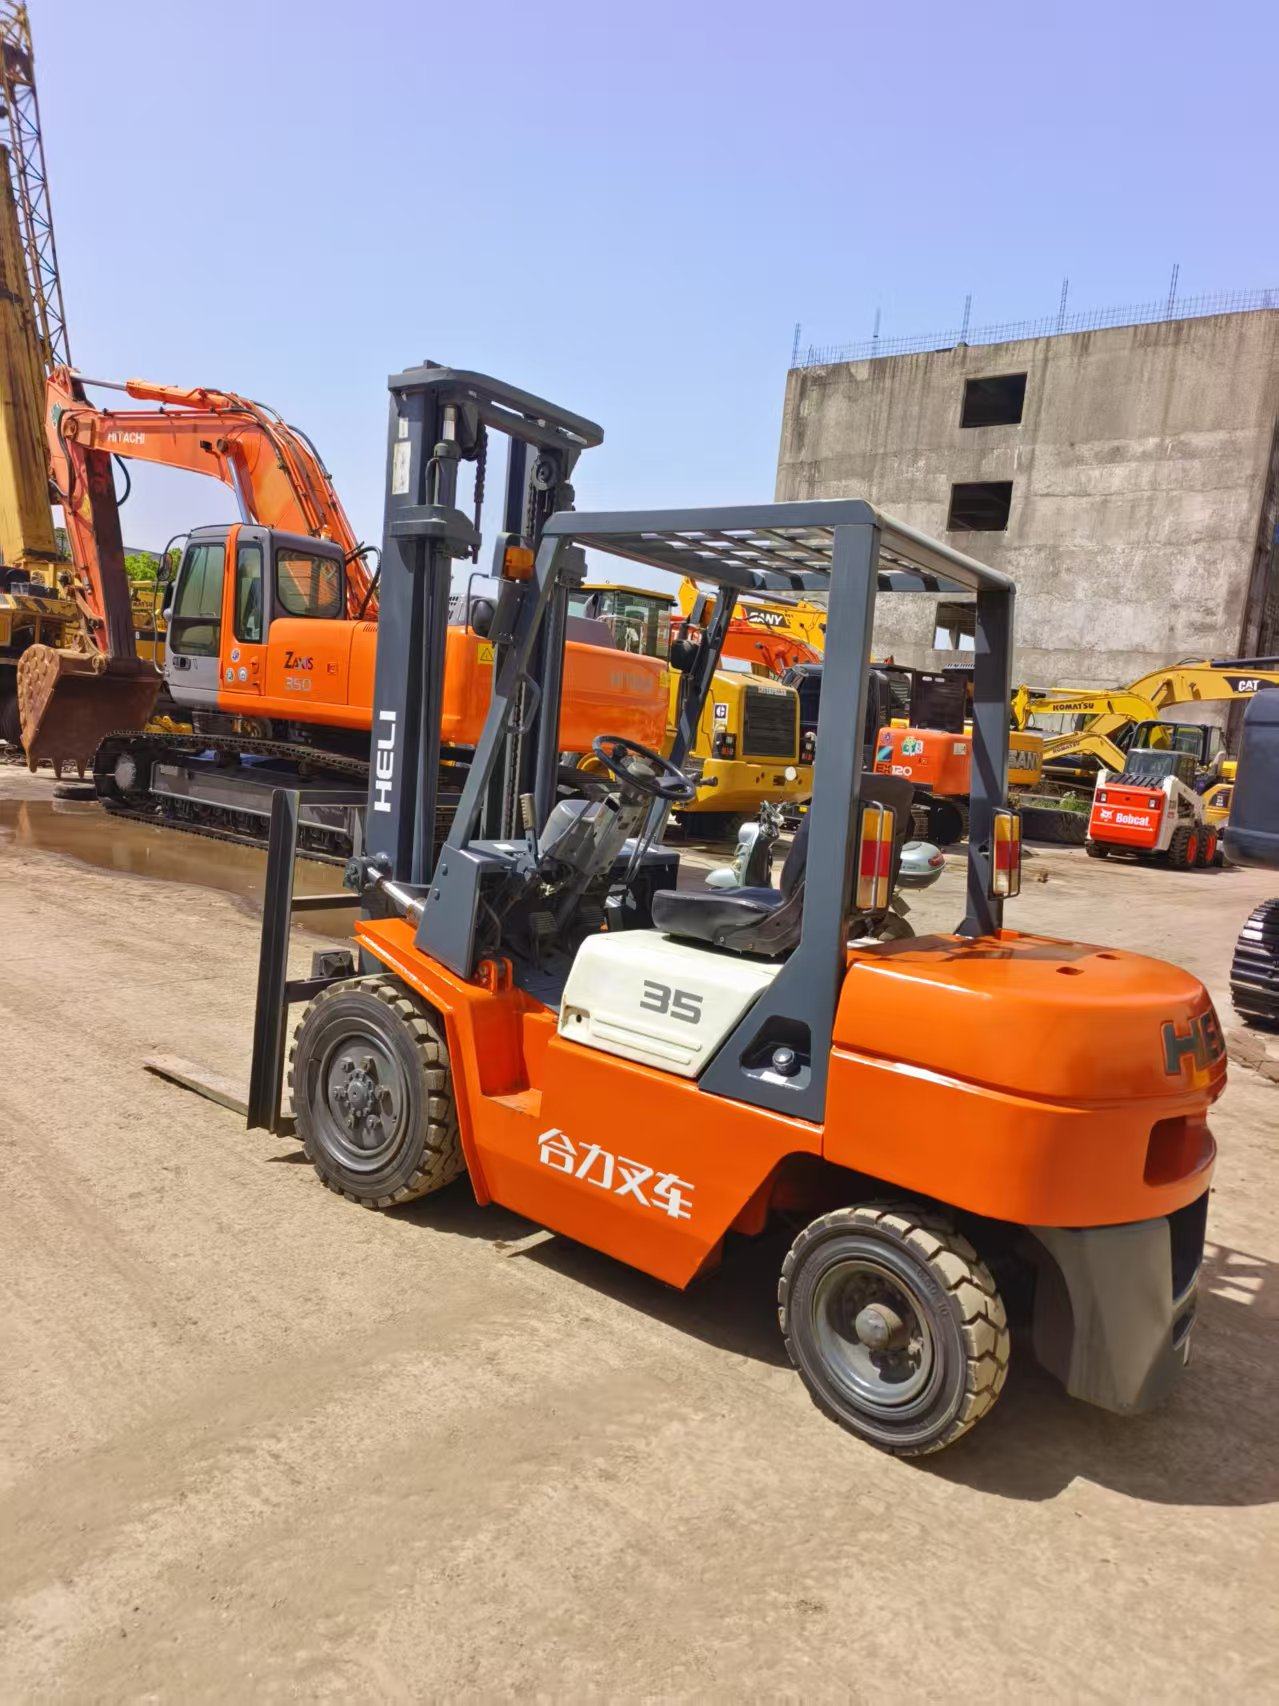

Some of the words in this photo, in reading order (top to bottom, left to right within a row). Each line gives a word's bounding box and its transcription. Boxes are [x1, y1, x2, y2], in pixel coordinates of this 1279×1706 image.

[107, 431, 146, 445] HITACHI
[1238, 680, 1260, 692] CAT
[1053, 702, 1094, 711] KOMATSU
[374, 710, 396, 812] HELI
[1116, 812, 1149, 826] Bobcat
[640, 979, 703, 1025] 35
[537, 1128, 695, 1219] 合力叉车
